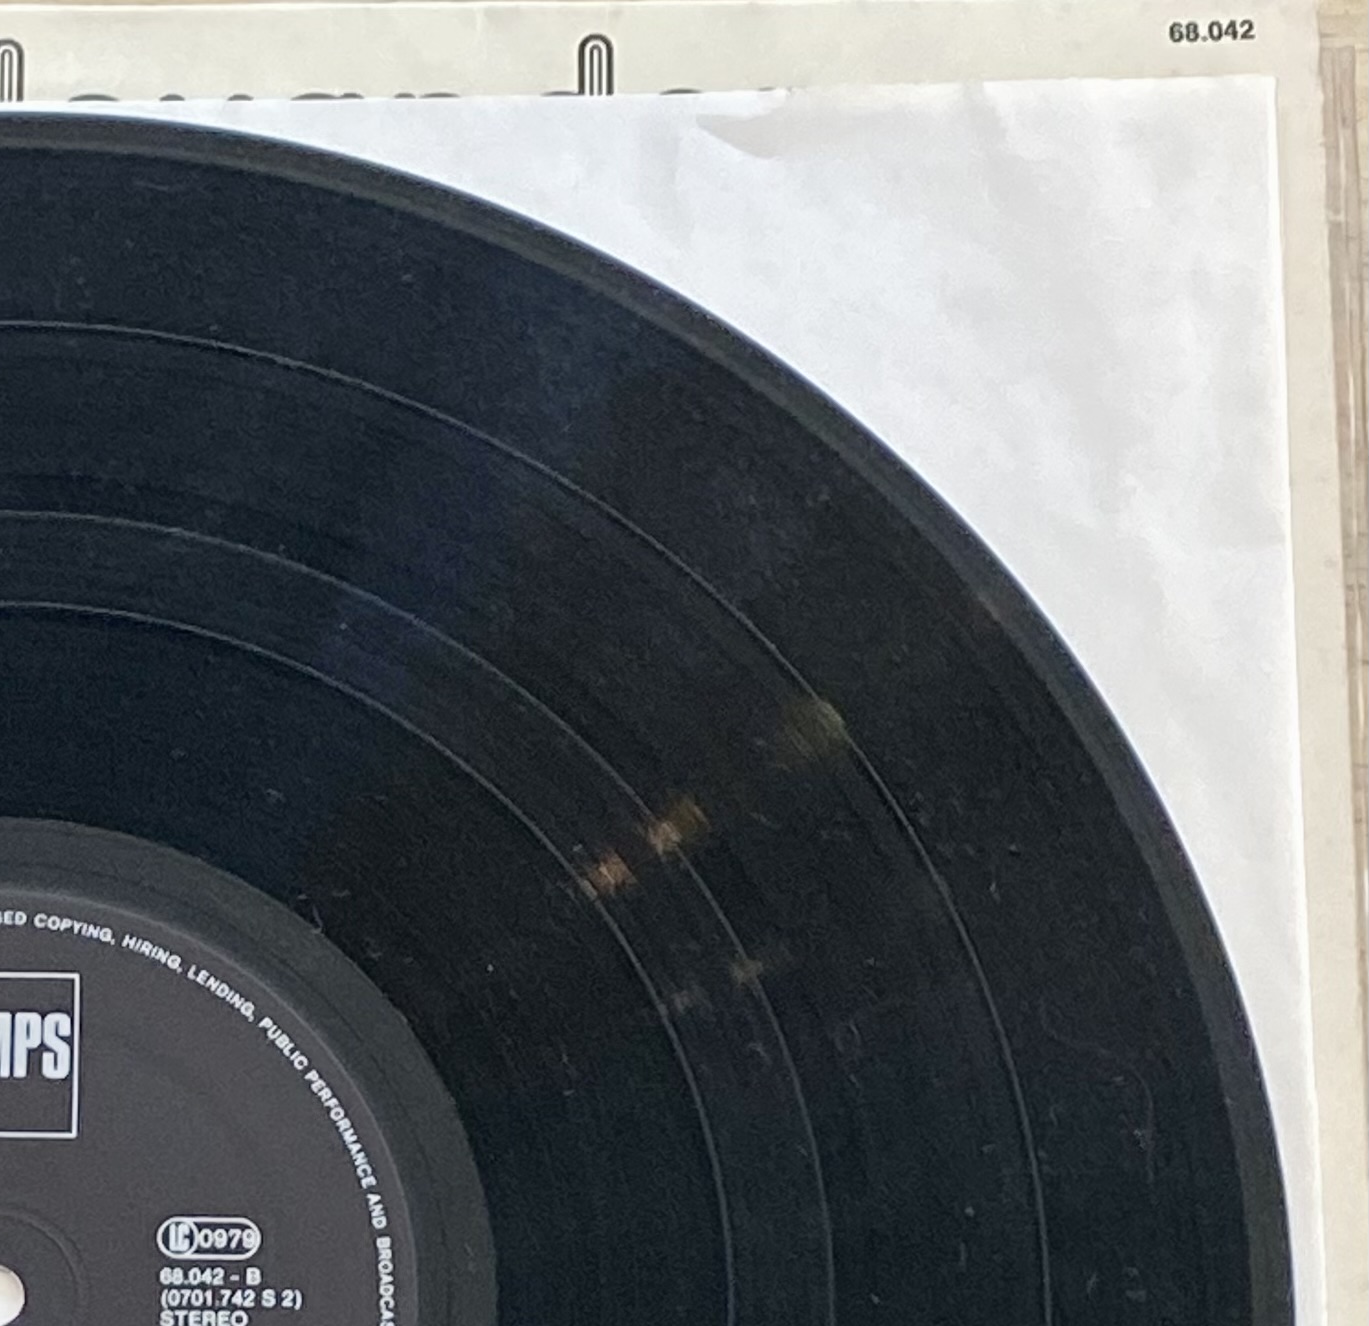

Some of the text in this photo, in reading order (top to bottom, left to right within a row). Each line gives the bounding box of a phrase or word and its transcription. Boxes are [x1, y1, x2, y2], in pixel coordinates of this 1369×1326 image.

[1169, 19, 1256, 43] 68.042
[33, 913, 116, 945] COPYING,
[121, 934, 182, 974] HIRING,
[187, 964, 255, 1022] LENDING,
[258, 1016, 308, 1070] PUBLIC
[304, 1069, 377, 1189] PERFORMANCE
[366, 1193, 387, 1230] AND
[198, 1228, 257, 1249] 0979
[159, 1266, 225, 1286] 68.042
[245, 1266, 262, 1286] B
[261, 1288, 276, 1308] S
[280, 1288, 303, 1311] 2)
